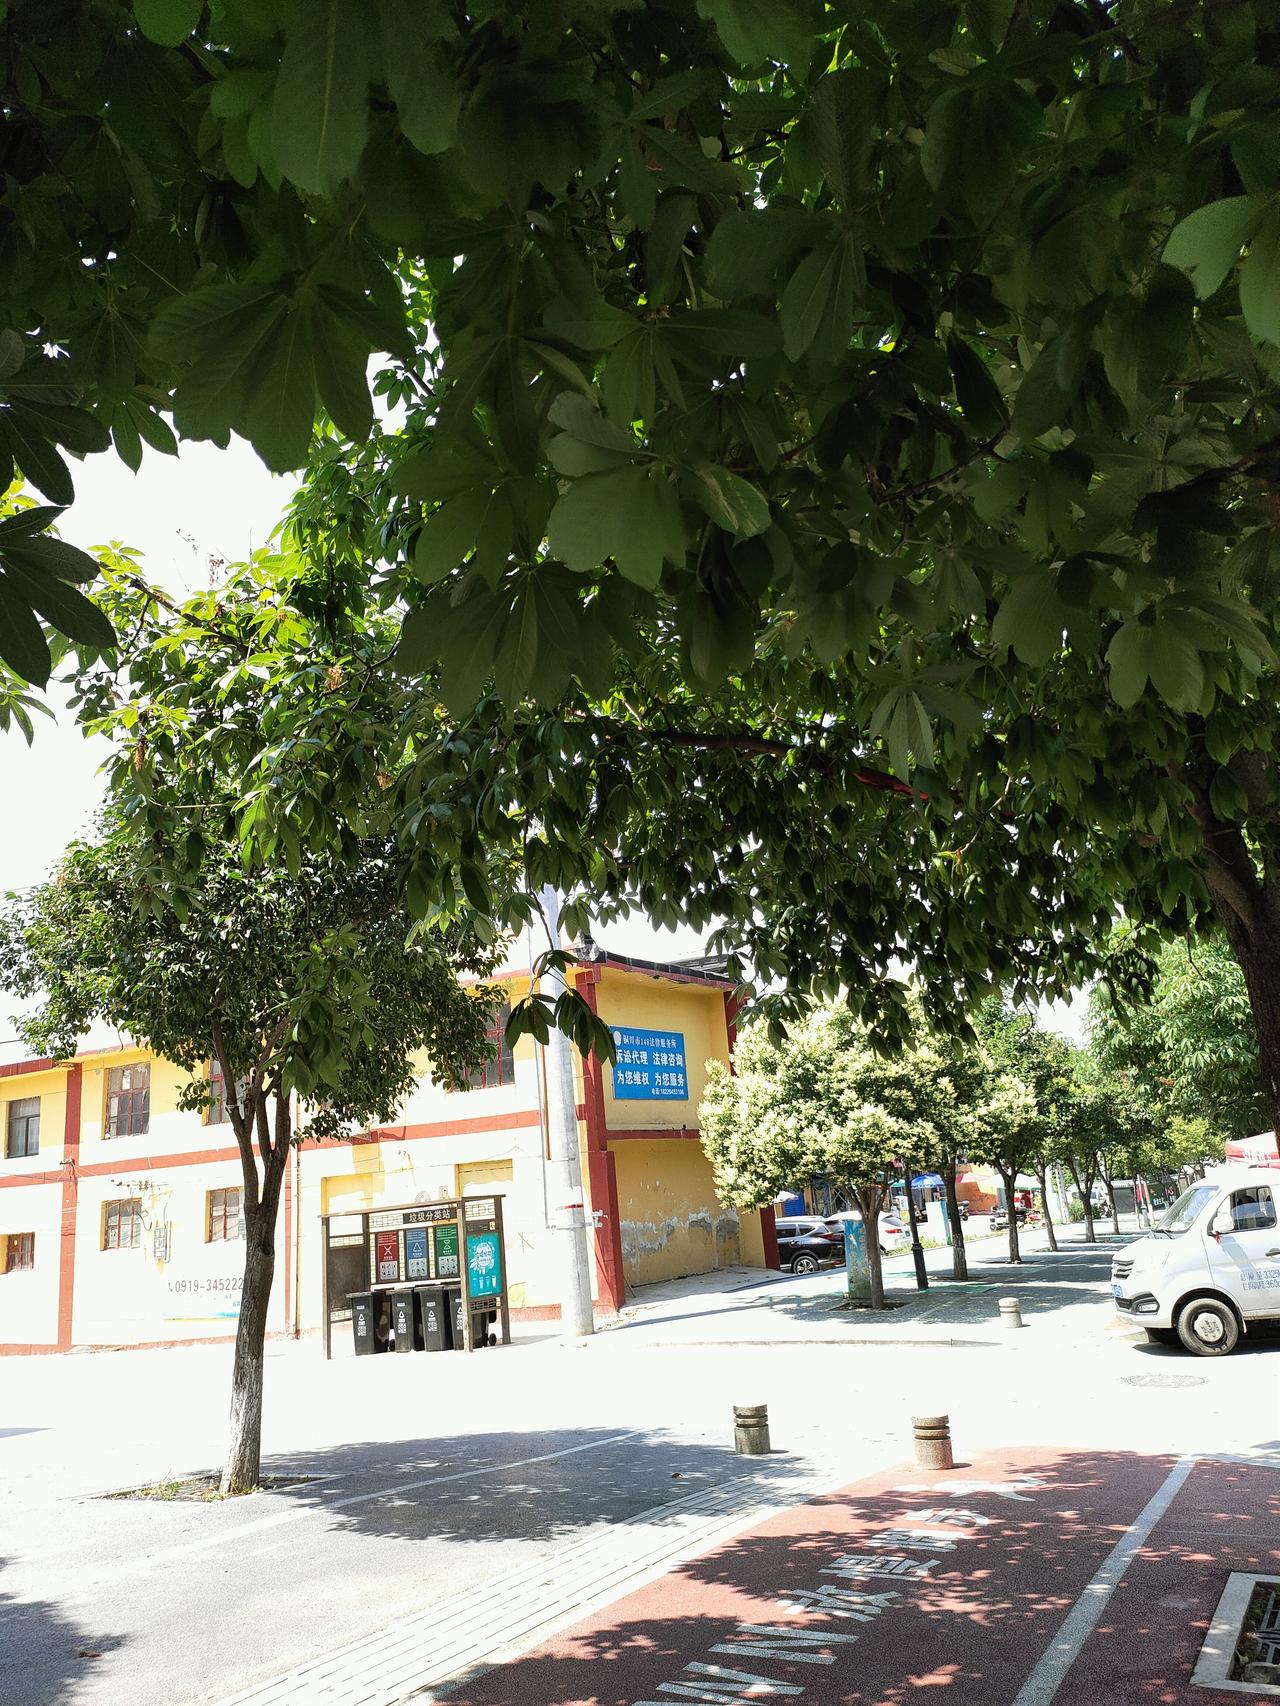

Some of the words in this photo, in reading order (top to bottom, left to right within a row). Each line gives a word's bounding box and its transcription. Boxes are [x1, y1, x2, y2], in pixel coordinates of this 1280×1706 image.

[616, 1049, 648, 1064] 诉讼代理
[653, 1052, 683, 1067] 法律咨询
[617, 1071, 650, 1085] 为您维权
[655, 1073, 685, 1087] 为您服务
[409, 1209, 450, 1222] 垃圾分类站
[775, 1508, 991, 1622] 放慢脚步
